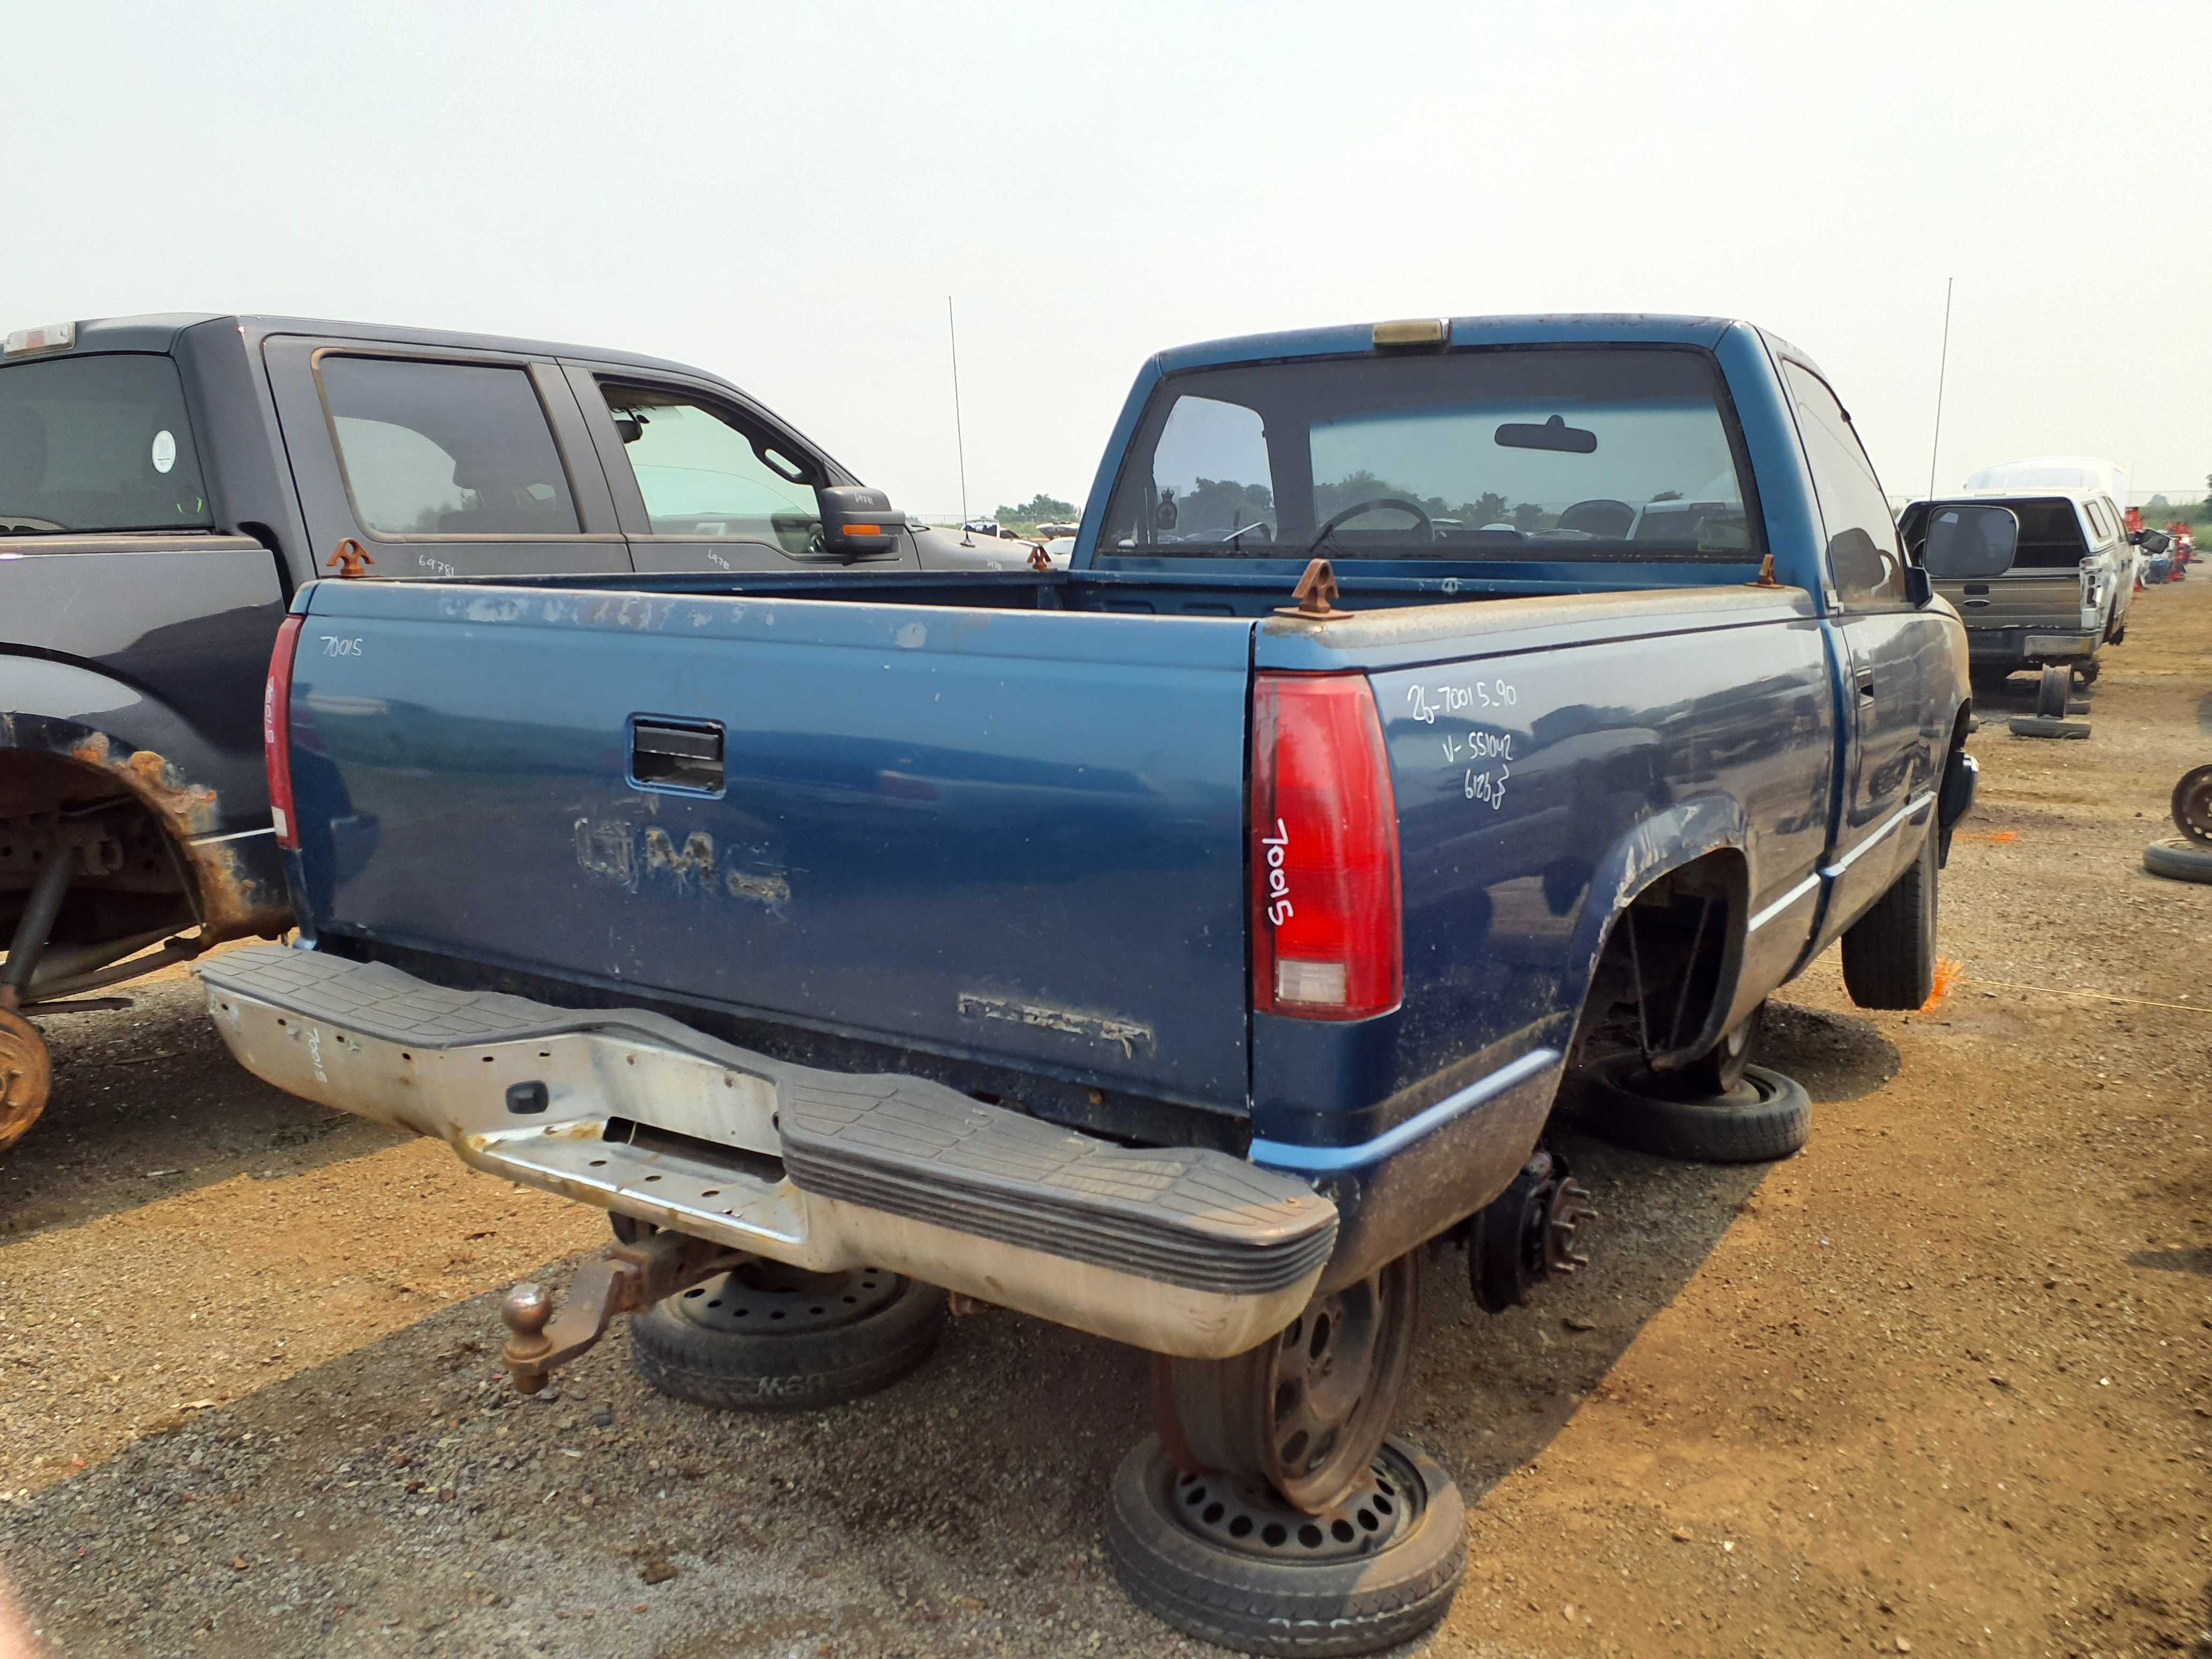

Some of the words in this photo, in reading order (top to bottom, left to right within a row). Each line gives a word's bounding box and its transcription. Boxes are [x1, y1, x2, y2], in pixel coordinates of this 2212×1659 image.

[419, 555, 454, 578] 69781
[320, 636, 363, 657] 70015
[1261, 817, 1294, 926] 70015
